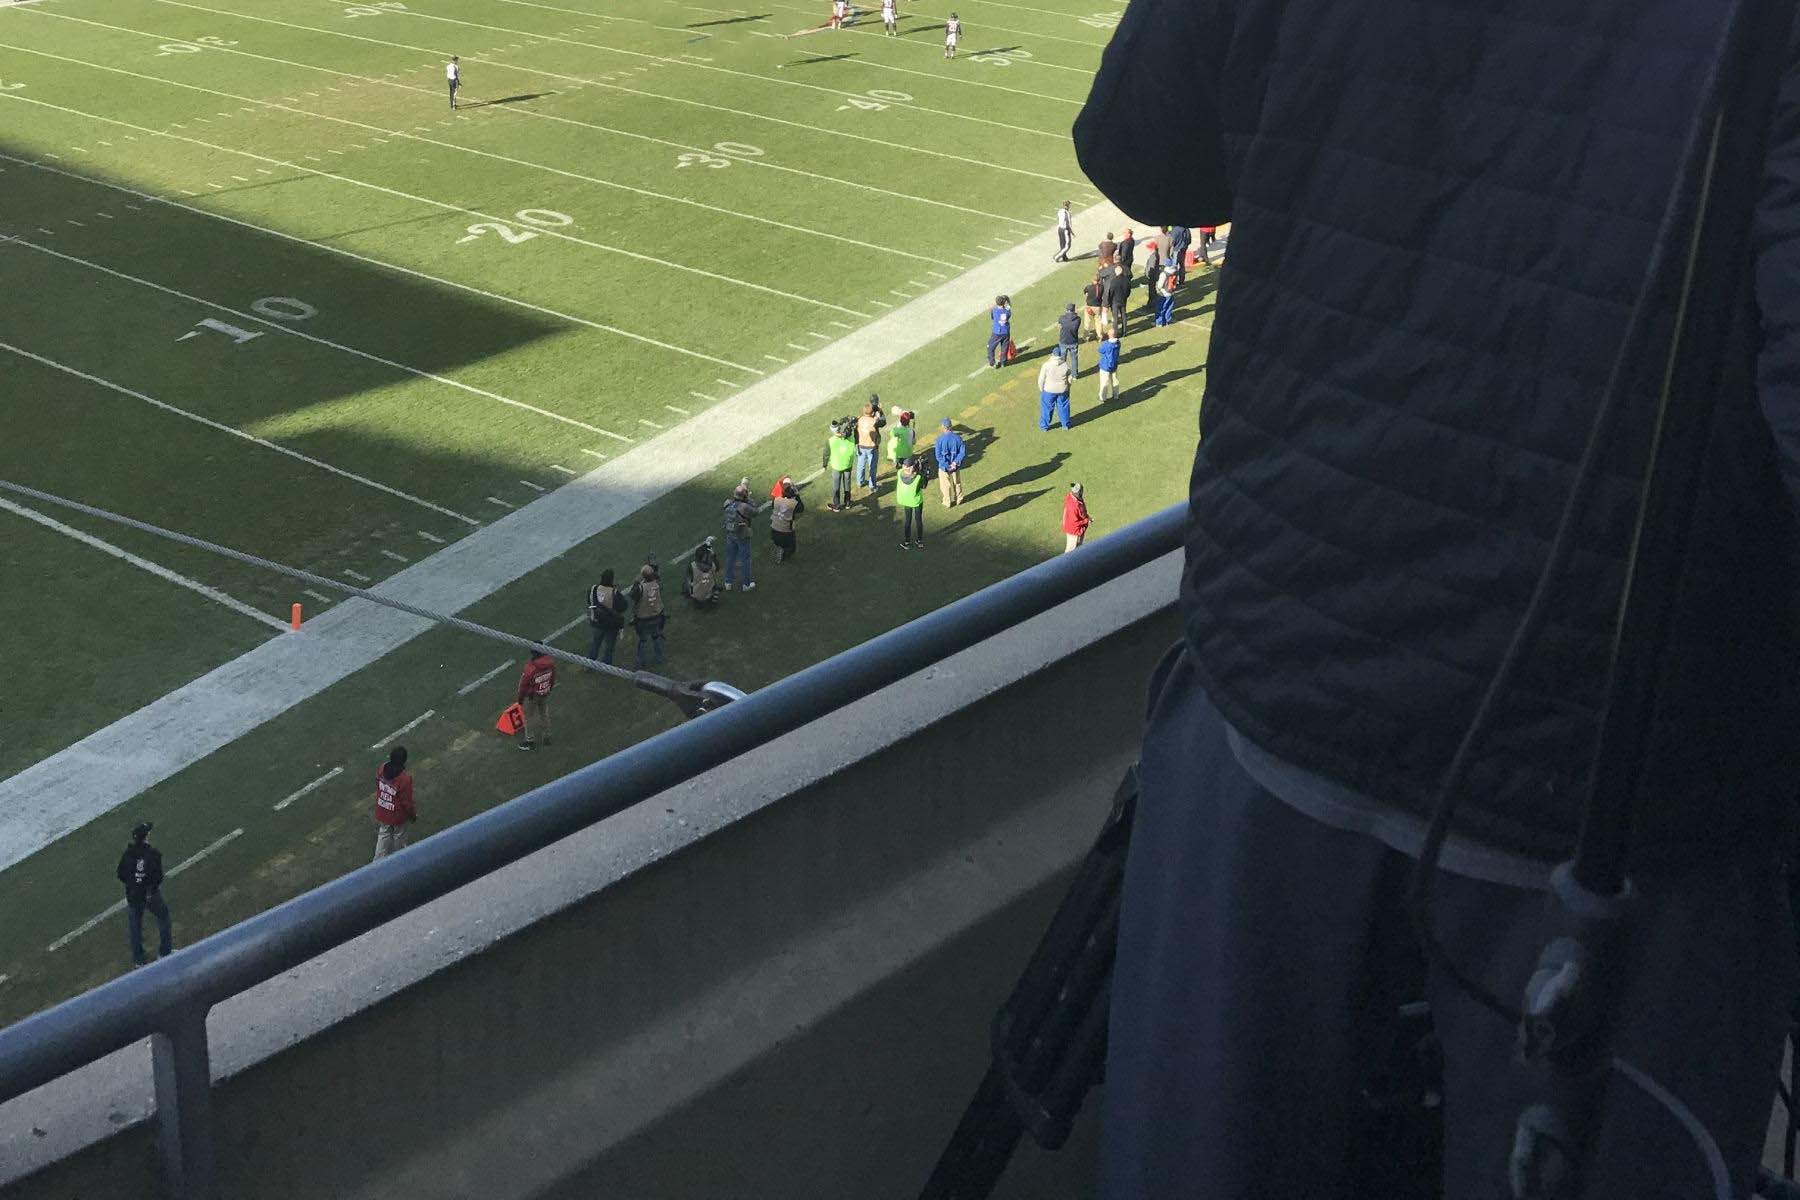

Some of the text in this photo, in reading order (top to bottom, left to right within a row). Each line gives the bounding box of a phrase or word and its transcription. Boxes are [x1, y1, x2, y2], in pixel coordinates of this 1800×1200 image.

[848, 89, 914, 111] 40
[678, 141, 765, 169] 30
[466, 208, 574, 244] 20
[195, 296, 319, 345] 10
